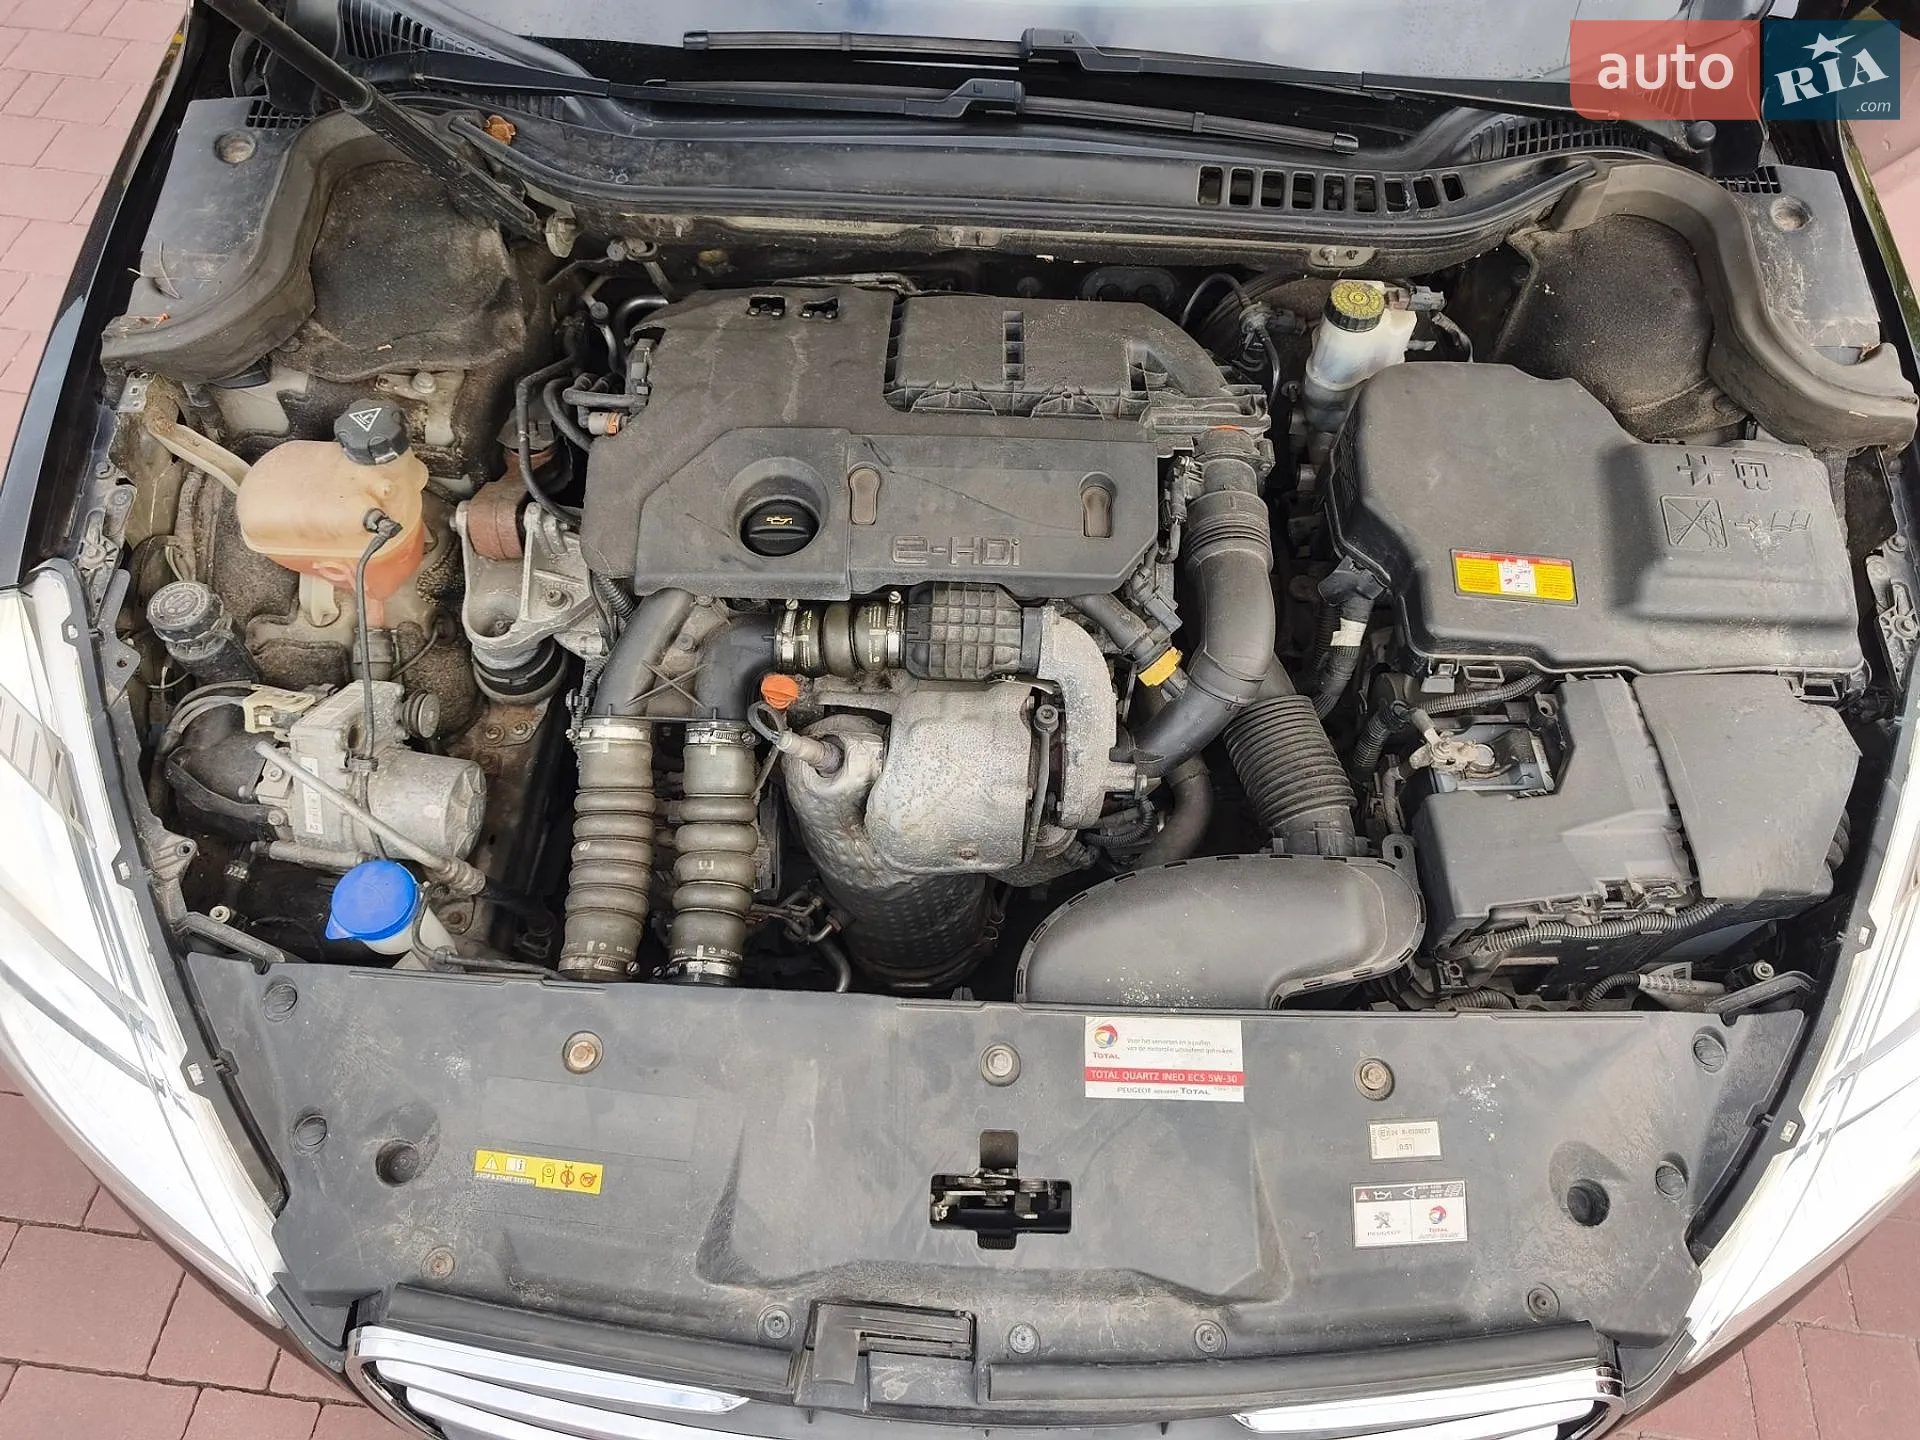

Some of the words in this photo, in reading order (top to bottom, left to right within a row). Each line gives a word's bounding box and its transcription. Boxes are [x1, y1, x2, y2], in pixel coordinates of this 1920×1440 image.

[1093, 1052, 1120, 1060] TOTAL
[1091, 1071, 1120, 1080] TOTAL
[1122, 1072, 1160, 1081] QUARTZ
[1162, 1072, 1185, 1082] INEO
[1188, 1073, 1205, 1082] ECS
[1208, 1074, 1237, 1083] 5W-30
[1180, 1087, 1211, 1095] TOTAL
